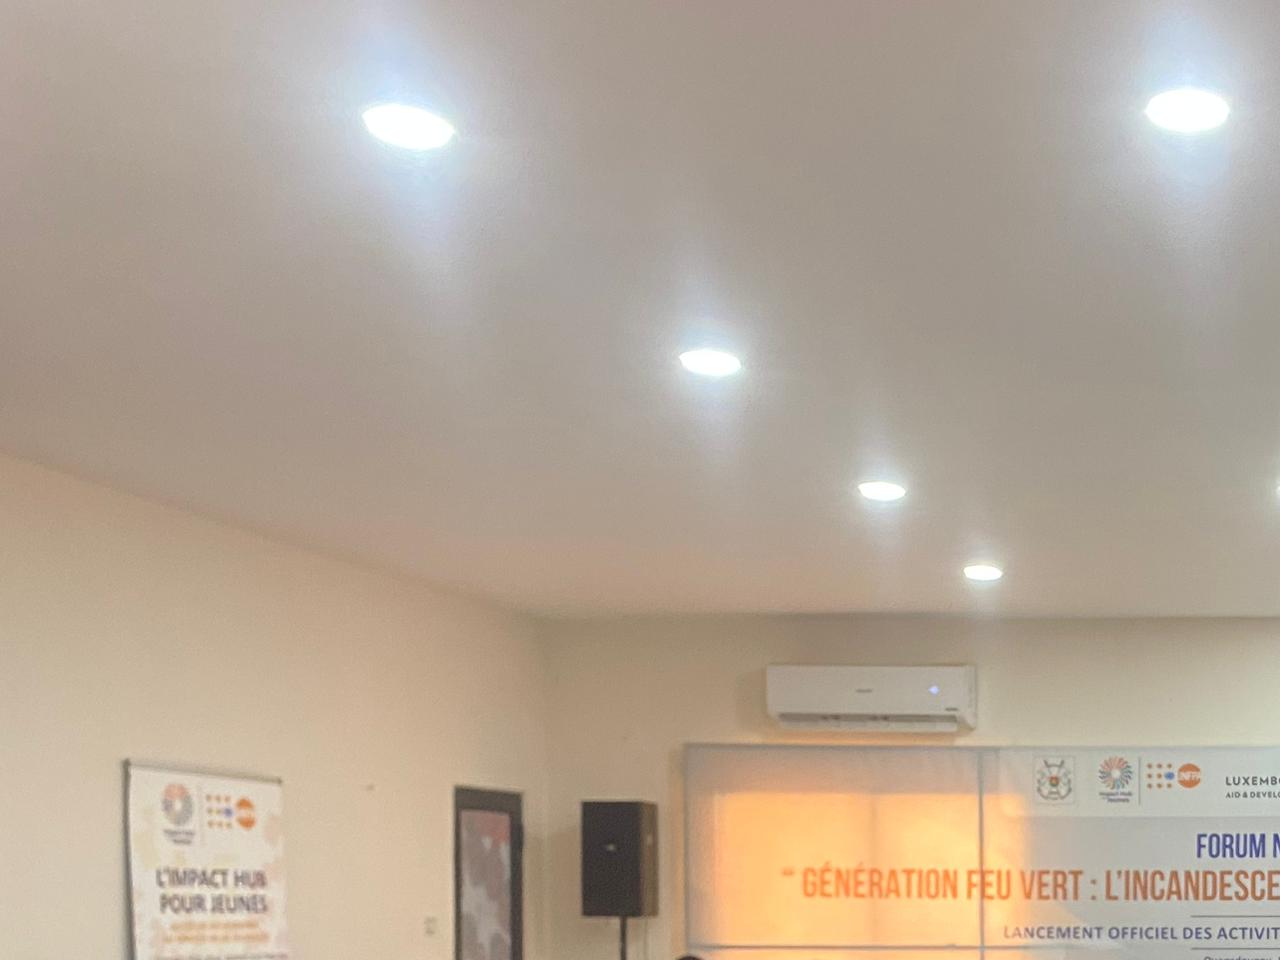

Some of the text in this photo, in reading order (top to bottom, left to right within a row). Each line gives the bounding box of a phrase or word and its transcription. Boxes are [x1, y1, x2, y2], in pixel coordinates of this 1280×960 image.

[1196, 833, 1266, 858] FORUM
[233, 869, 267, 890] HUB
[802, 862, 958, 899] GÉNÉRATION
[967, 868, 1012, 900] FEU
[1020, 870, 1084, 901] VERT
[160, 893, 268, 914] POUR JEUNES
[1003, 925, 1103, 940] LANCEMENT
[1108, 927, 1178, 940] OFFICIEL
[1183, 927, 1212, 940] DES
